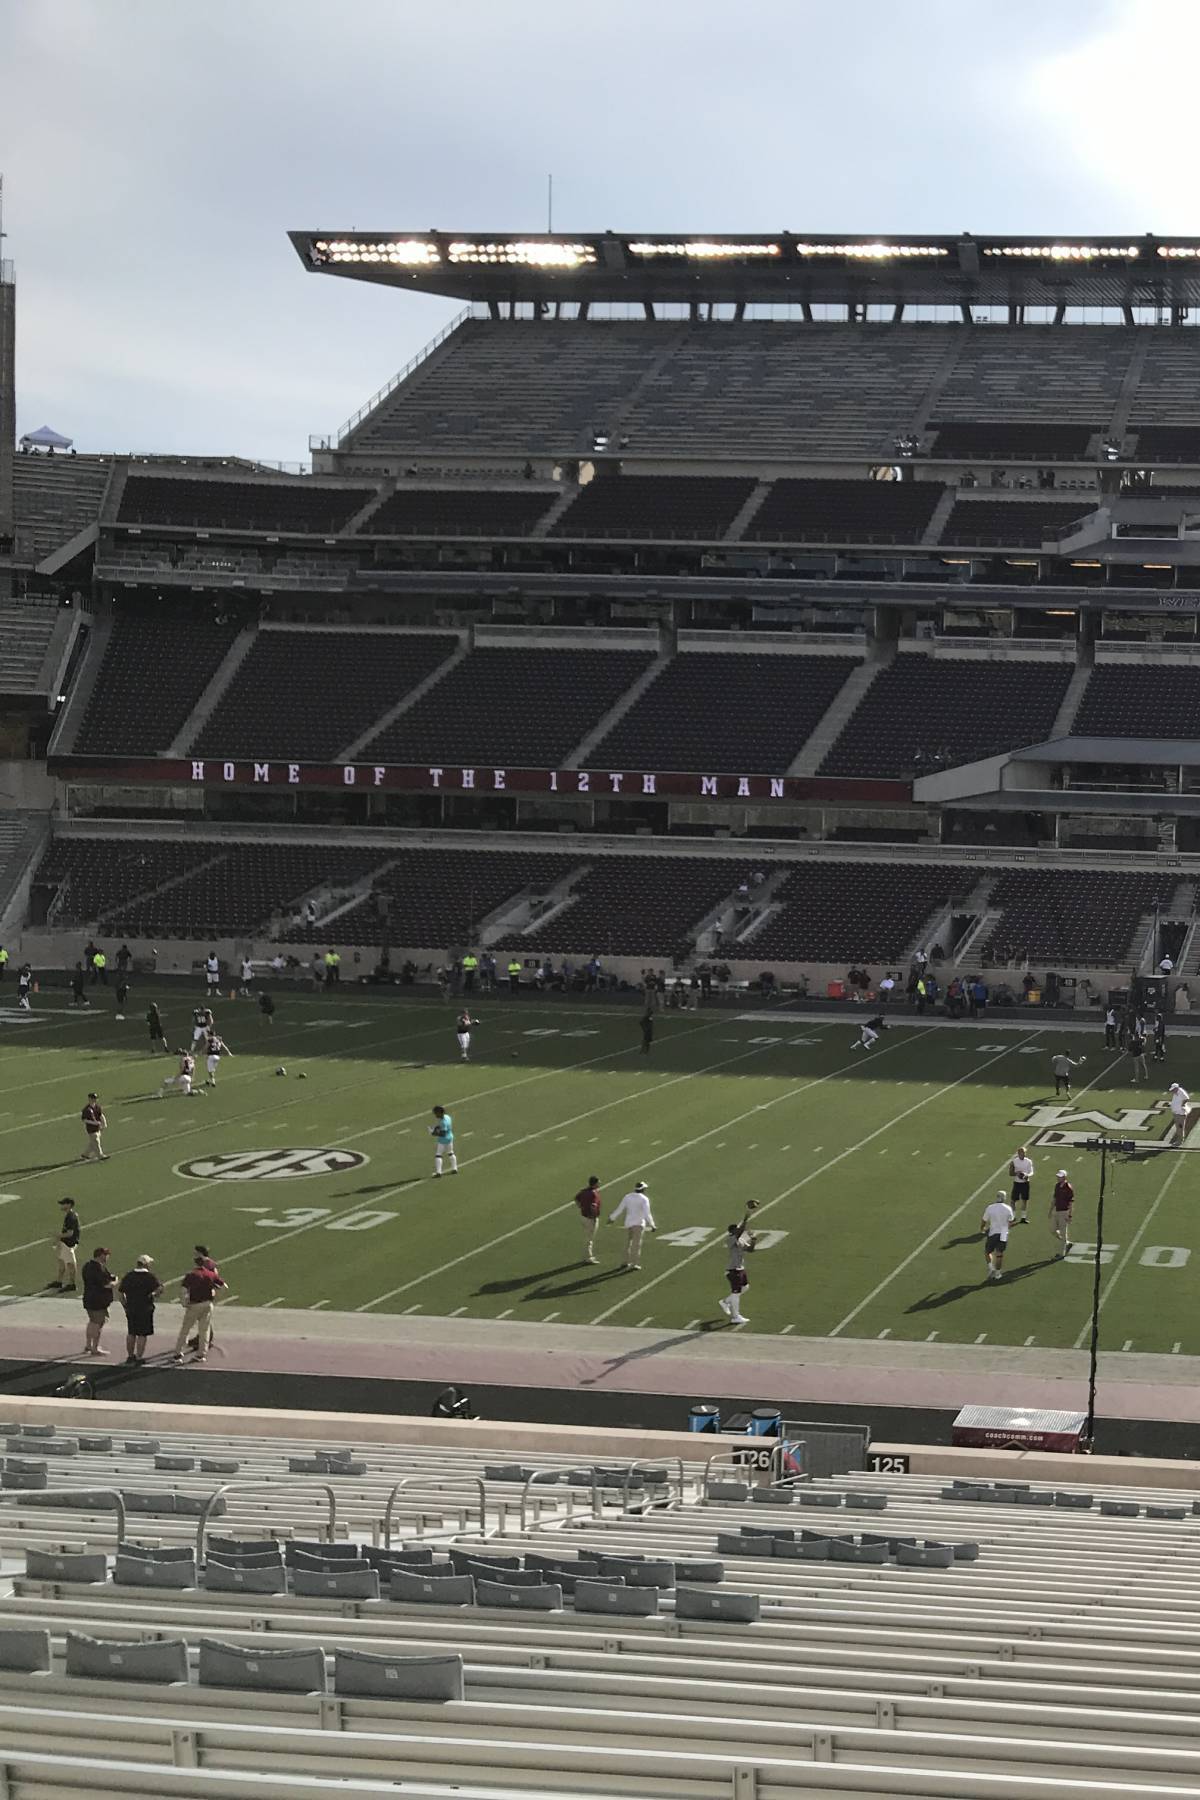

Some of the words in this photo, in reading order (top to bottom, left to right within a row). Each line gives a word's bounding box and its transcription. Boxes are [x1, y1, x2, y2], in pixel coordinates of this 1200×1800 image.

[192, 761, 300, 784] HOME
[343, 766, 386, 786] OF
[429, 768, 506, 789] THE
[549, 771, 656, 794] 12TH
[701, 776, 785, 798] MAN
[254, 1207, 400, 1231] 30
[1064, 1242, 1192, 1268] 50
[985, 1431, 1044, 1442] coachcomm.com
[740, 1450, 769, 1468] 126
[871, 1456, 905, 1474] 125
